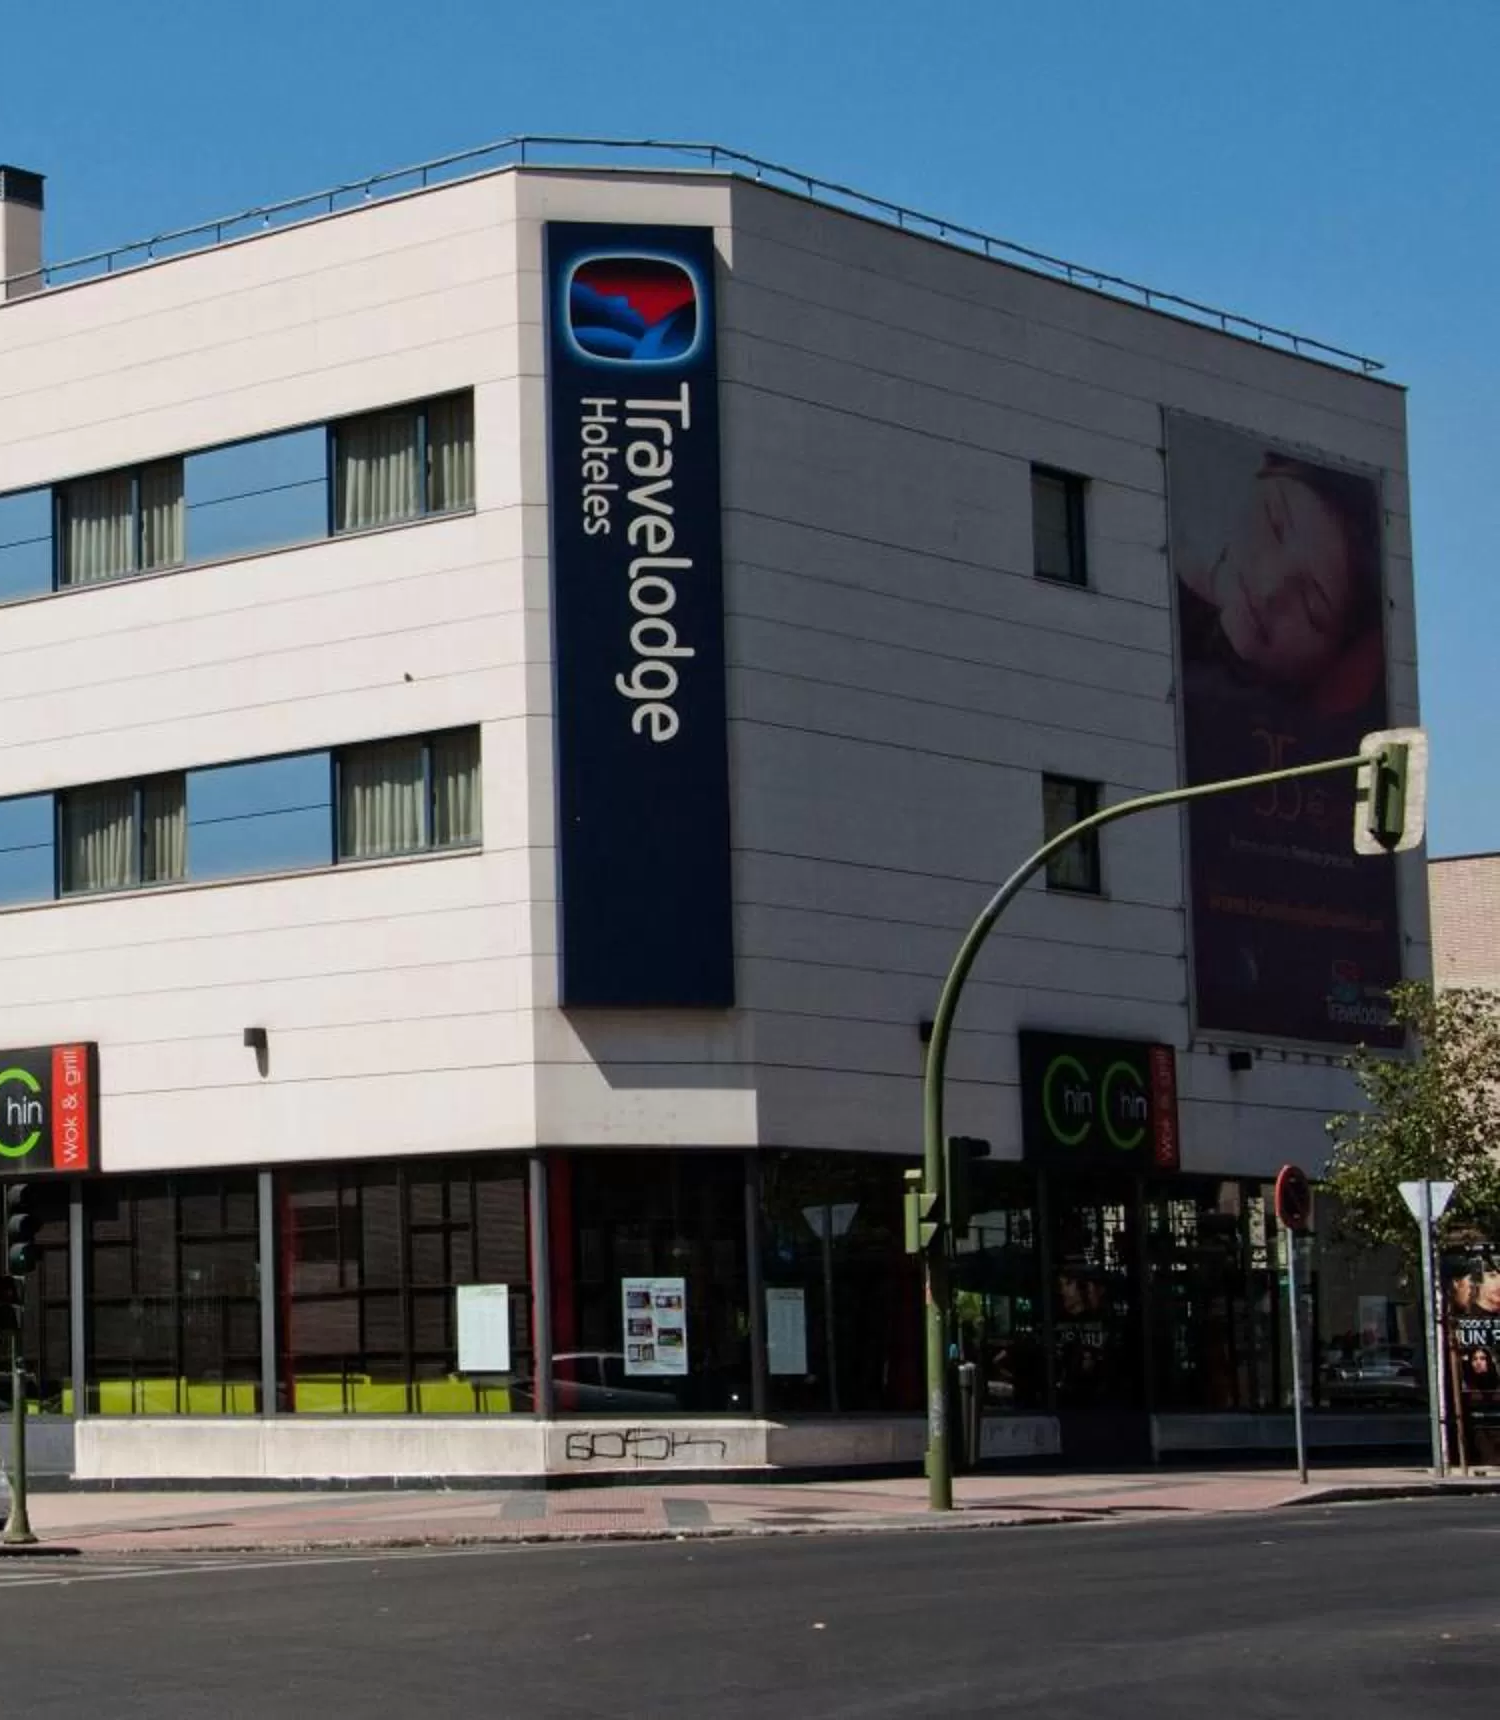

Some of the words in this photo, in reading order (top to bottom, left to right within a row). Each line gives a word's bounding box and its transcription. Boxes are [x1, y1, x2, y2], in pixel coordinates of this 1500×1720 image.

[580, 397, 618, 537] Hoteles
[616, 381, 696, 744] Travelodge
[63, 1051, 81, 1087] grill
